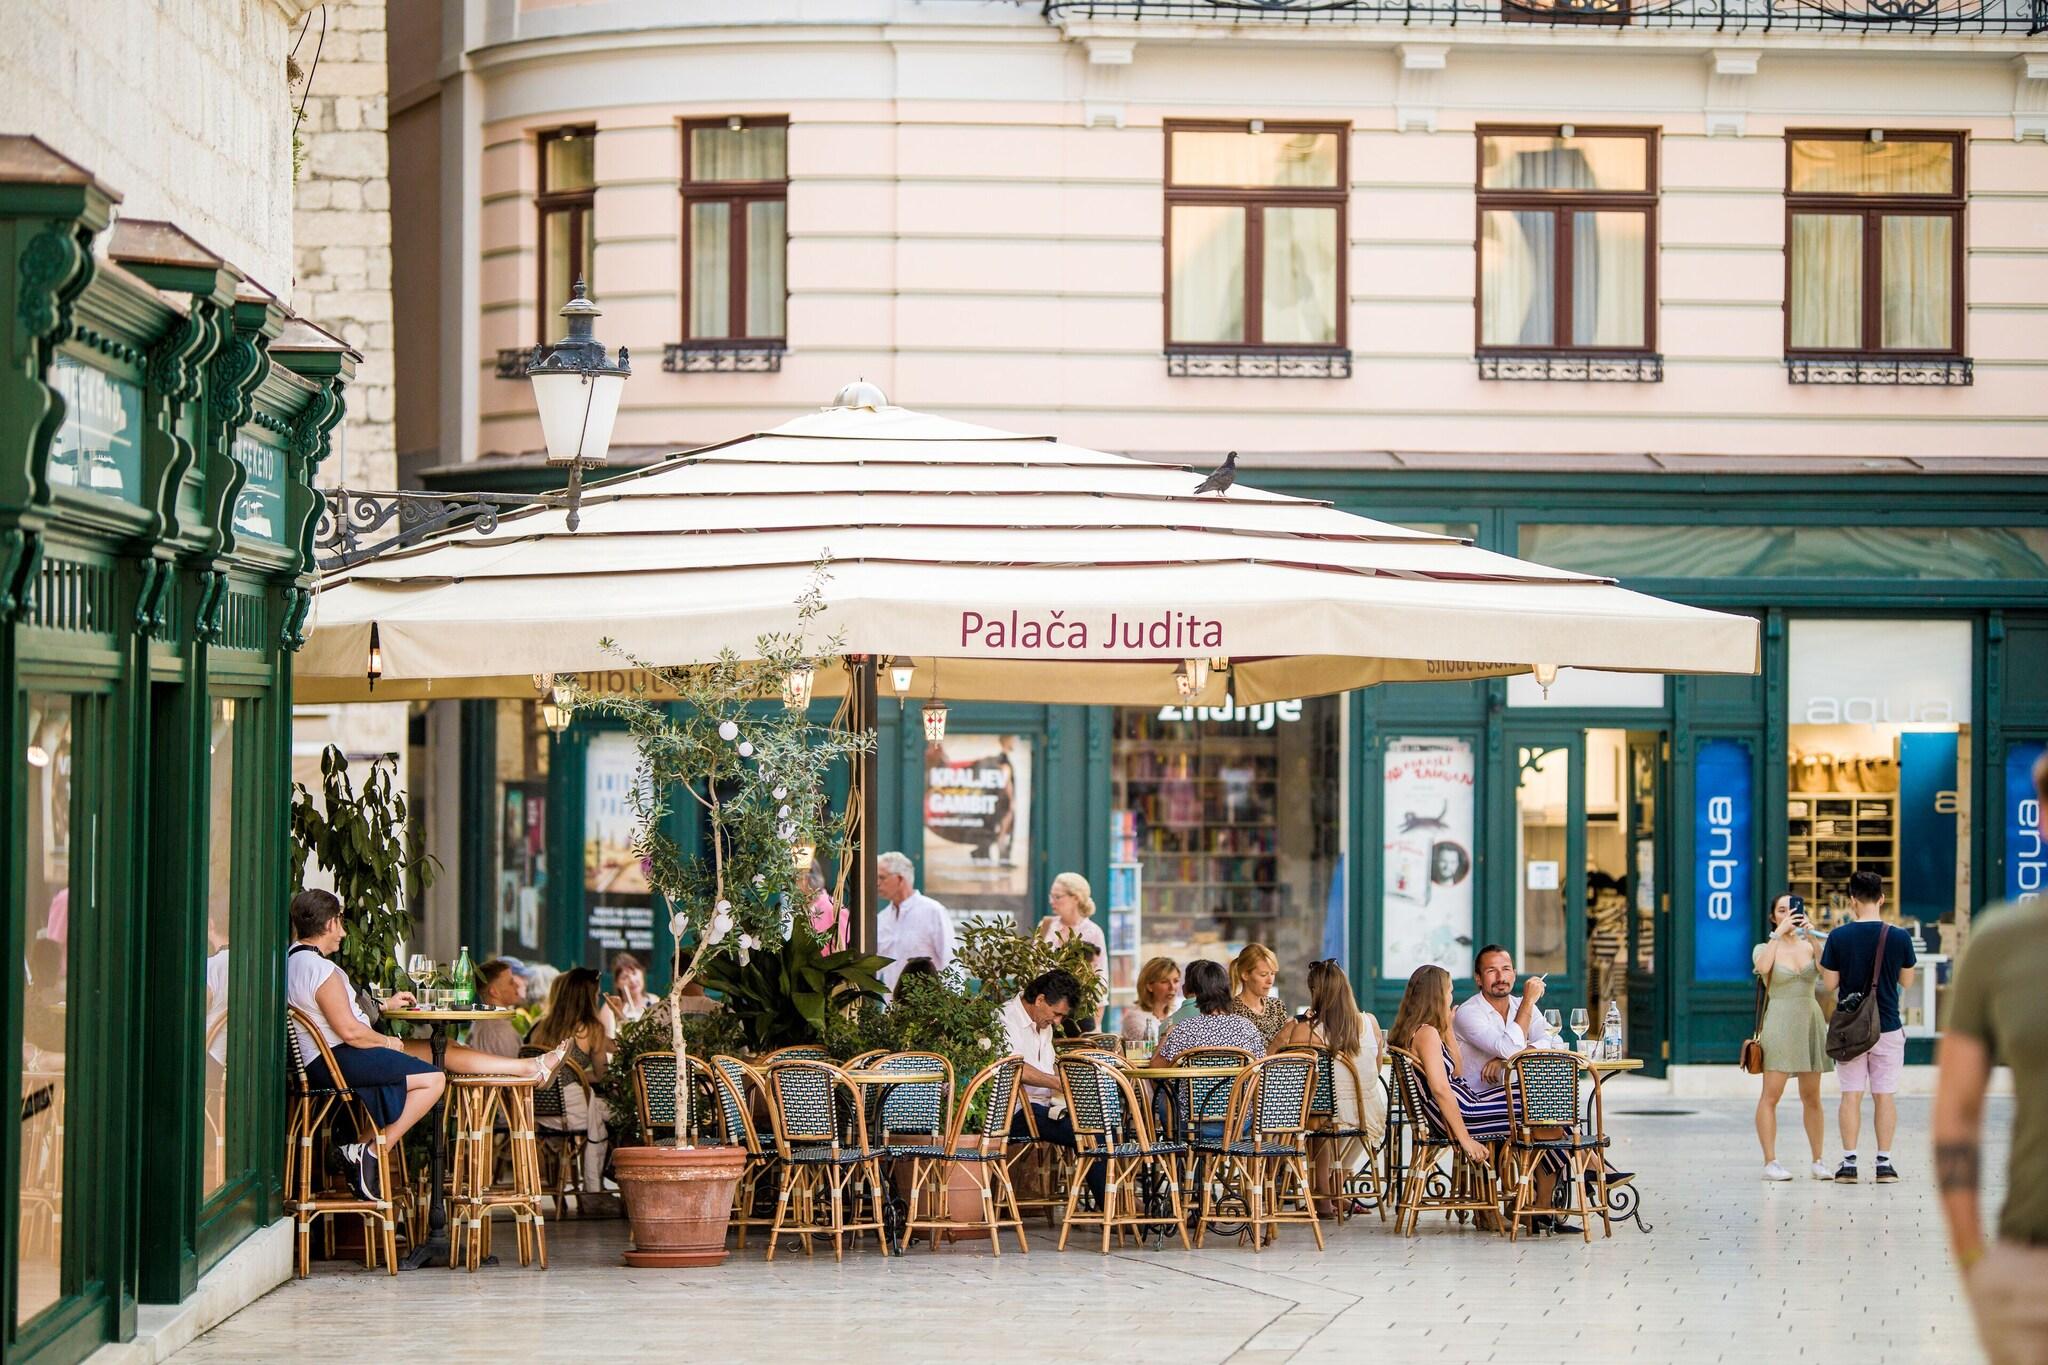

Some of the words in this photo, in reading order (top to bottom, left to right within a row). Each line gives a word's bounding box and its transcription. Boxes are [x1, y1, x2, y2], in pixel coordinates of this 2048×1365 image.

[961, 610, 1087, 648] Palača
[1103, 610, 1222, 648] Judita
[1806, 697, 1953, 734] aqua
[929, 794, 998, 815] GAMBIT
[1708, 796, 1738, 921] aqua
